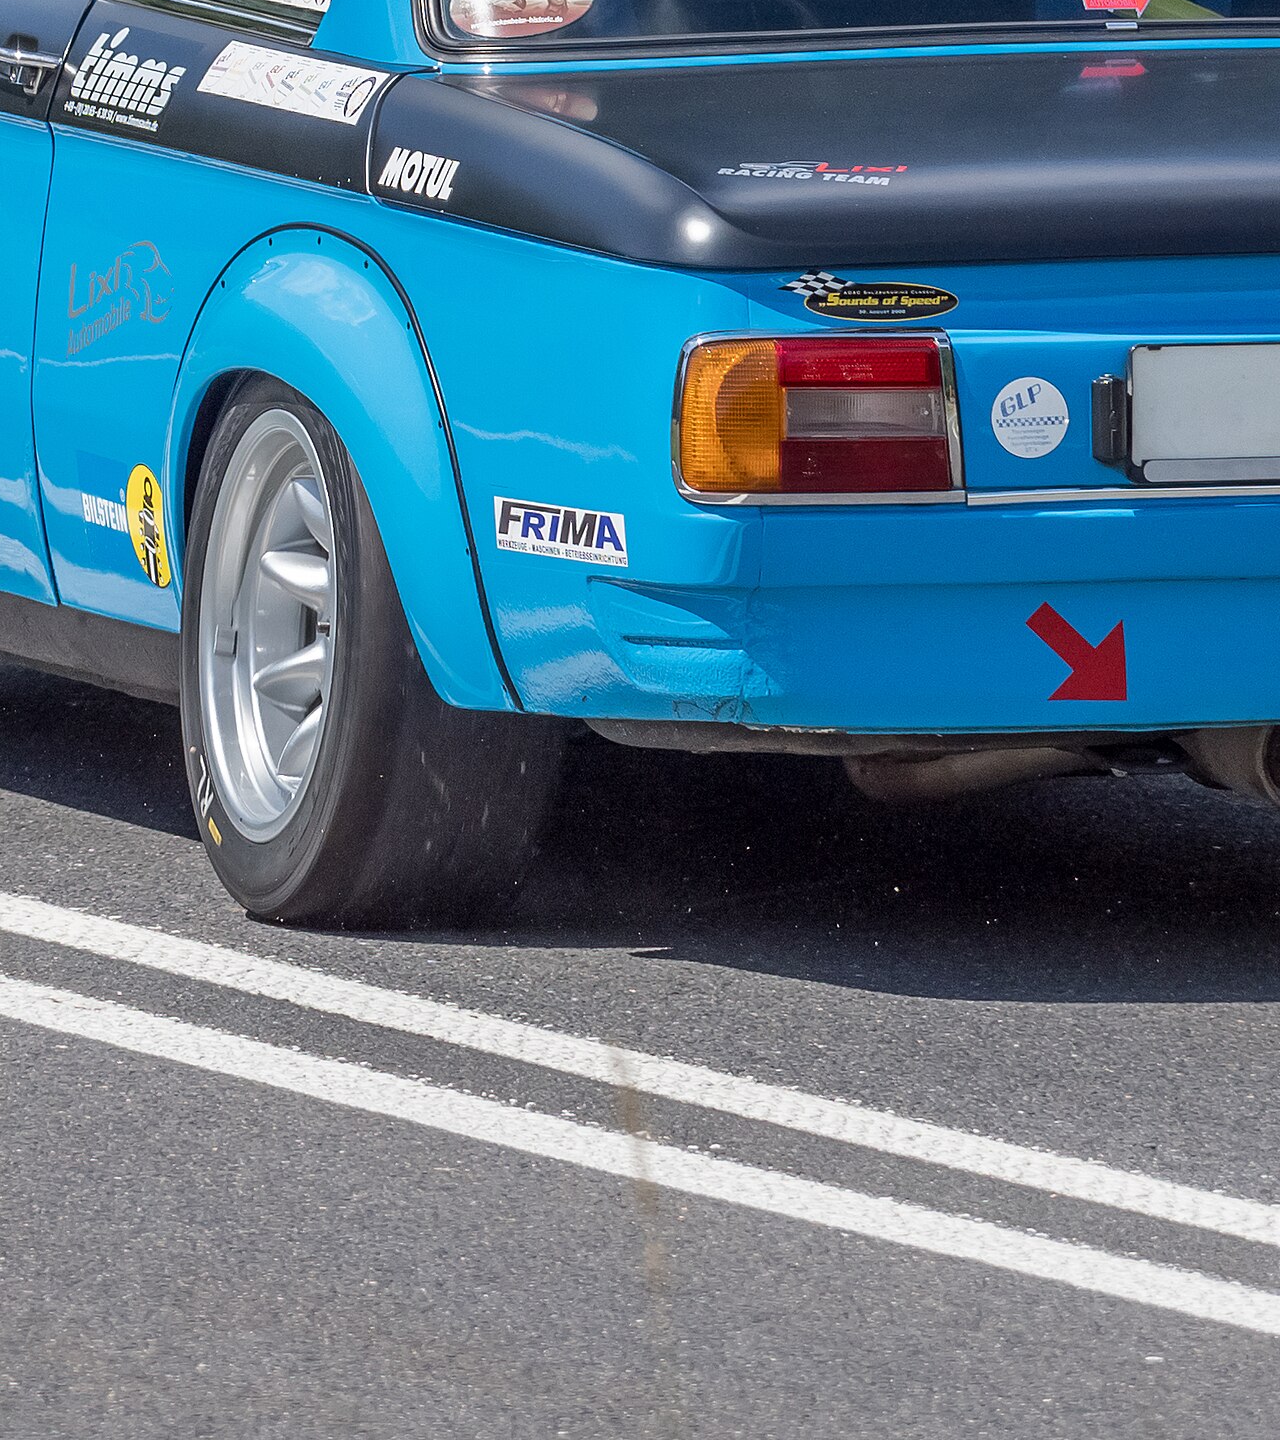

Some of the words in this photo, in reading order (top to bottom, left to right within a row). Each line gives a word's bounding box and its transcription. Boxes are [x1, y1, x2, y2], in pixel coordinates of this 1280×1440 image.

[377, 145, 461, 201] MOTUL
[717, 167, 813, 180] RACING
[822, 173, 891, 186] TEAM
[882, 294, 899, 306] of
[999, 383, 1042, 418] GLP
[80, 491, 129, 534] BILSTEIN
[498, 500, 625, 552] FRIMA
